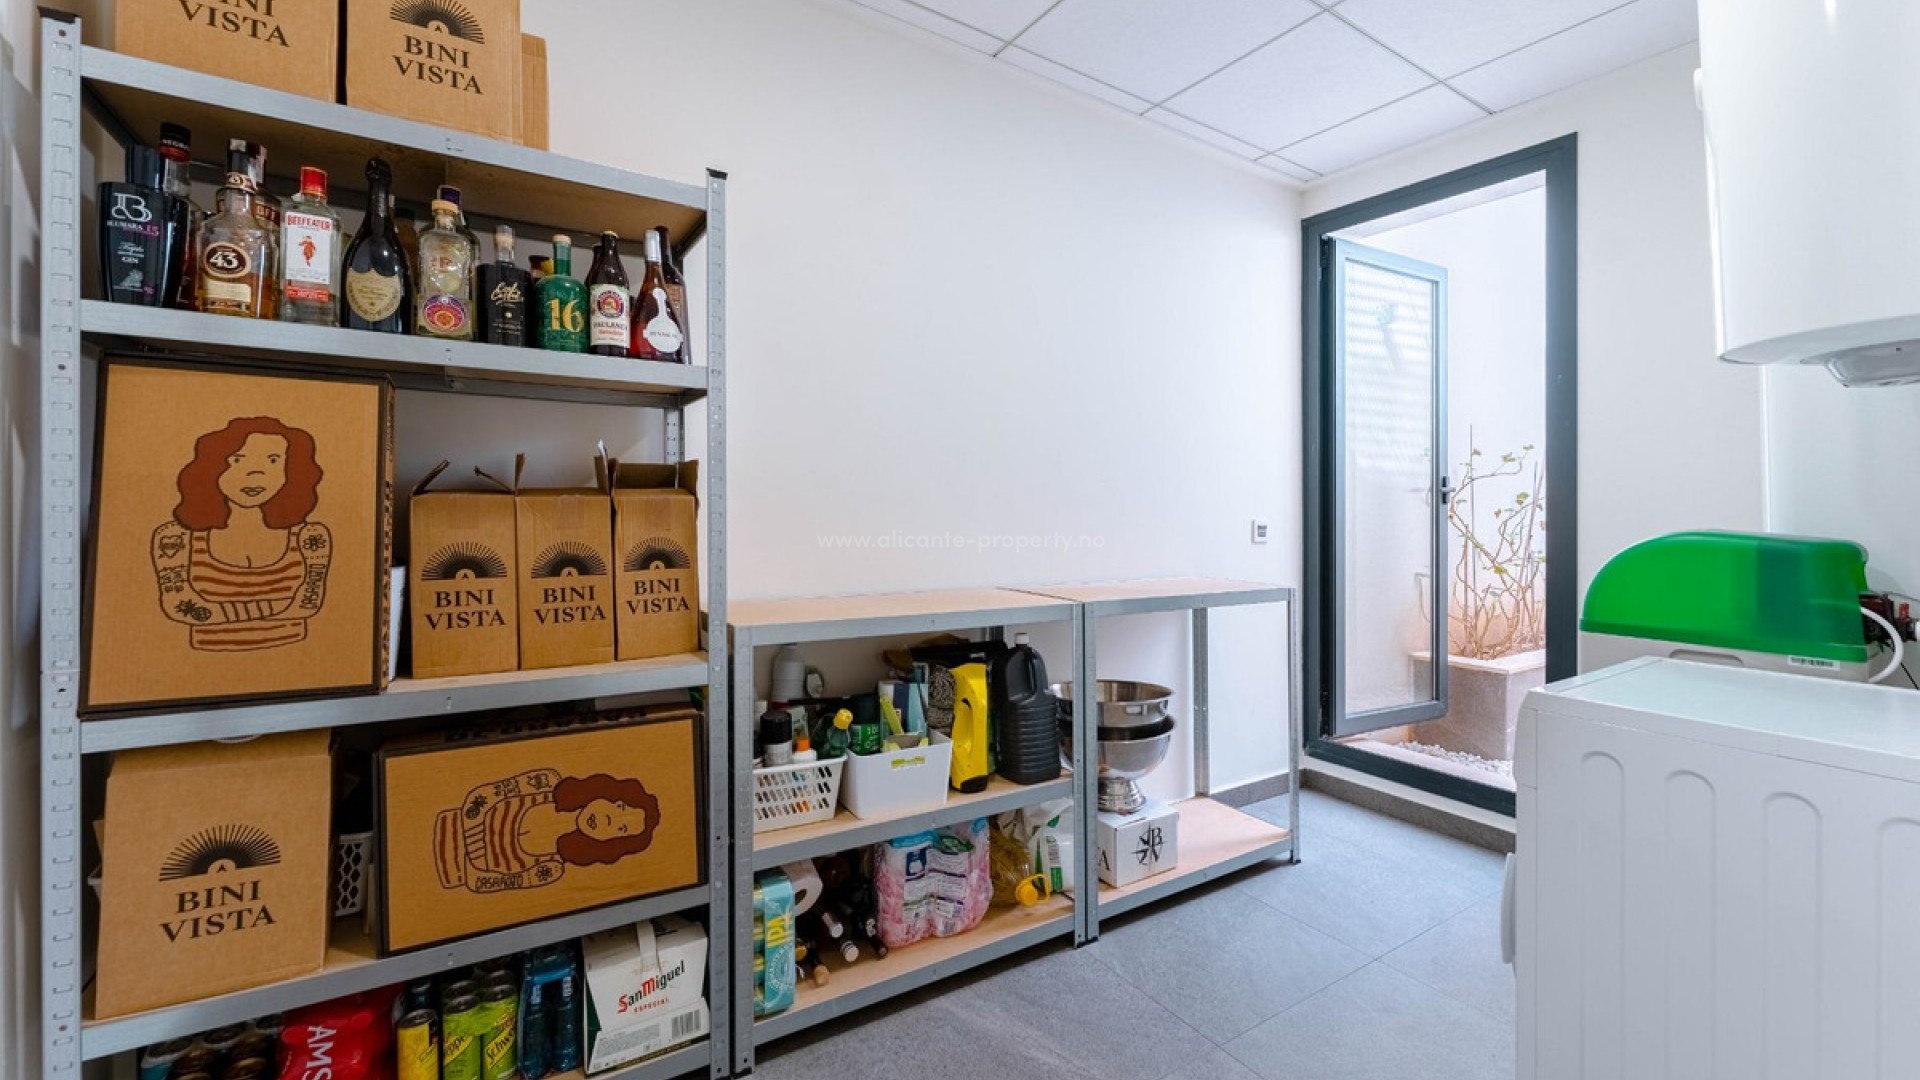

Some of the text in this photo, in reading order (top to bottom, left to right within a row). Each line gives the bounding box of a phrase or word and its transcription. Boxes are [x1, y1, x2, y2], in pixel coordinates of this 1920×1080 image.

[179, 0, 289, 47] VISTA
[404, 33, 470, 69] BINI
[393, 54, 484, 95] VISTA
[287, 214, 332, 232] BEEFEATER
[208, 251, 239, 270] 43
[545, 297, 585, 333] 16
[542, 585, 596, 604] BINI
[633, 578, 681, 596] BINI
[434, 589, 494, 608] BINI
[626, 596, 690, 615] VISTA
[425, 609, 507, 630] VISTA
[533, 604, 607, 624] VISTA
[176, 880, 261, 914] BINI
[160, 904, 276, 943] VISTA
